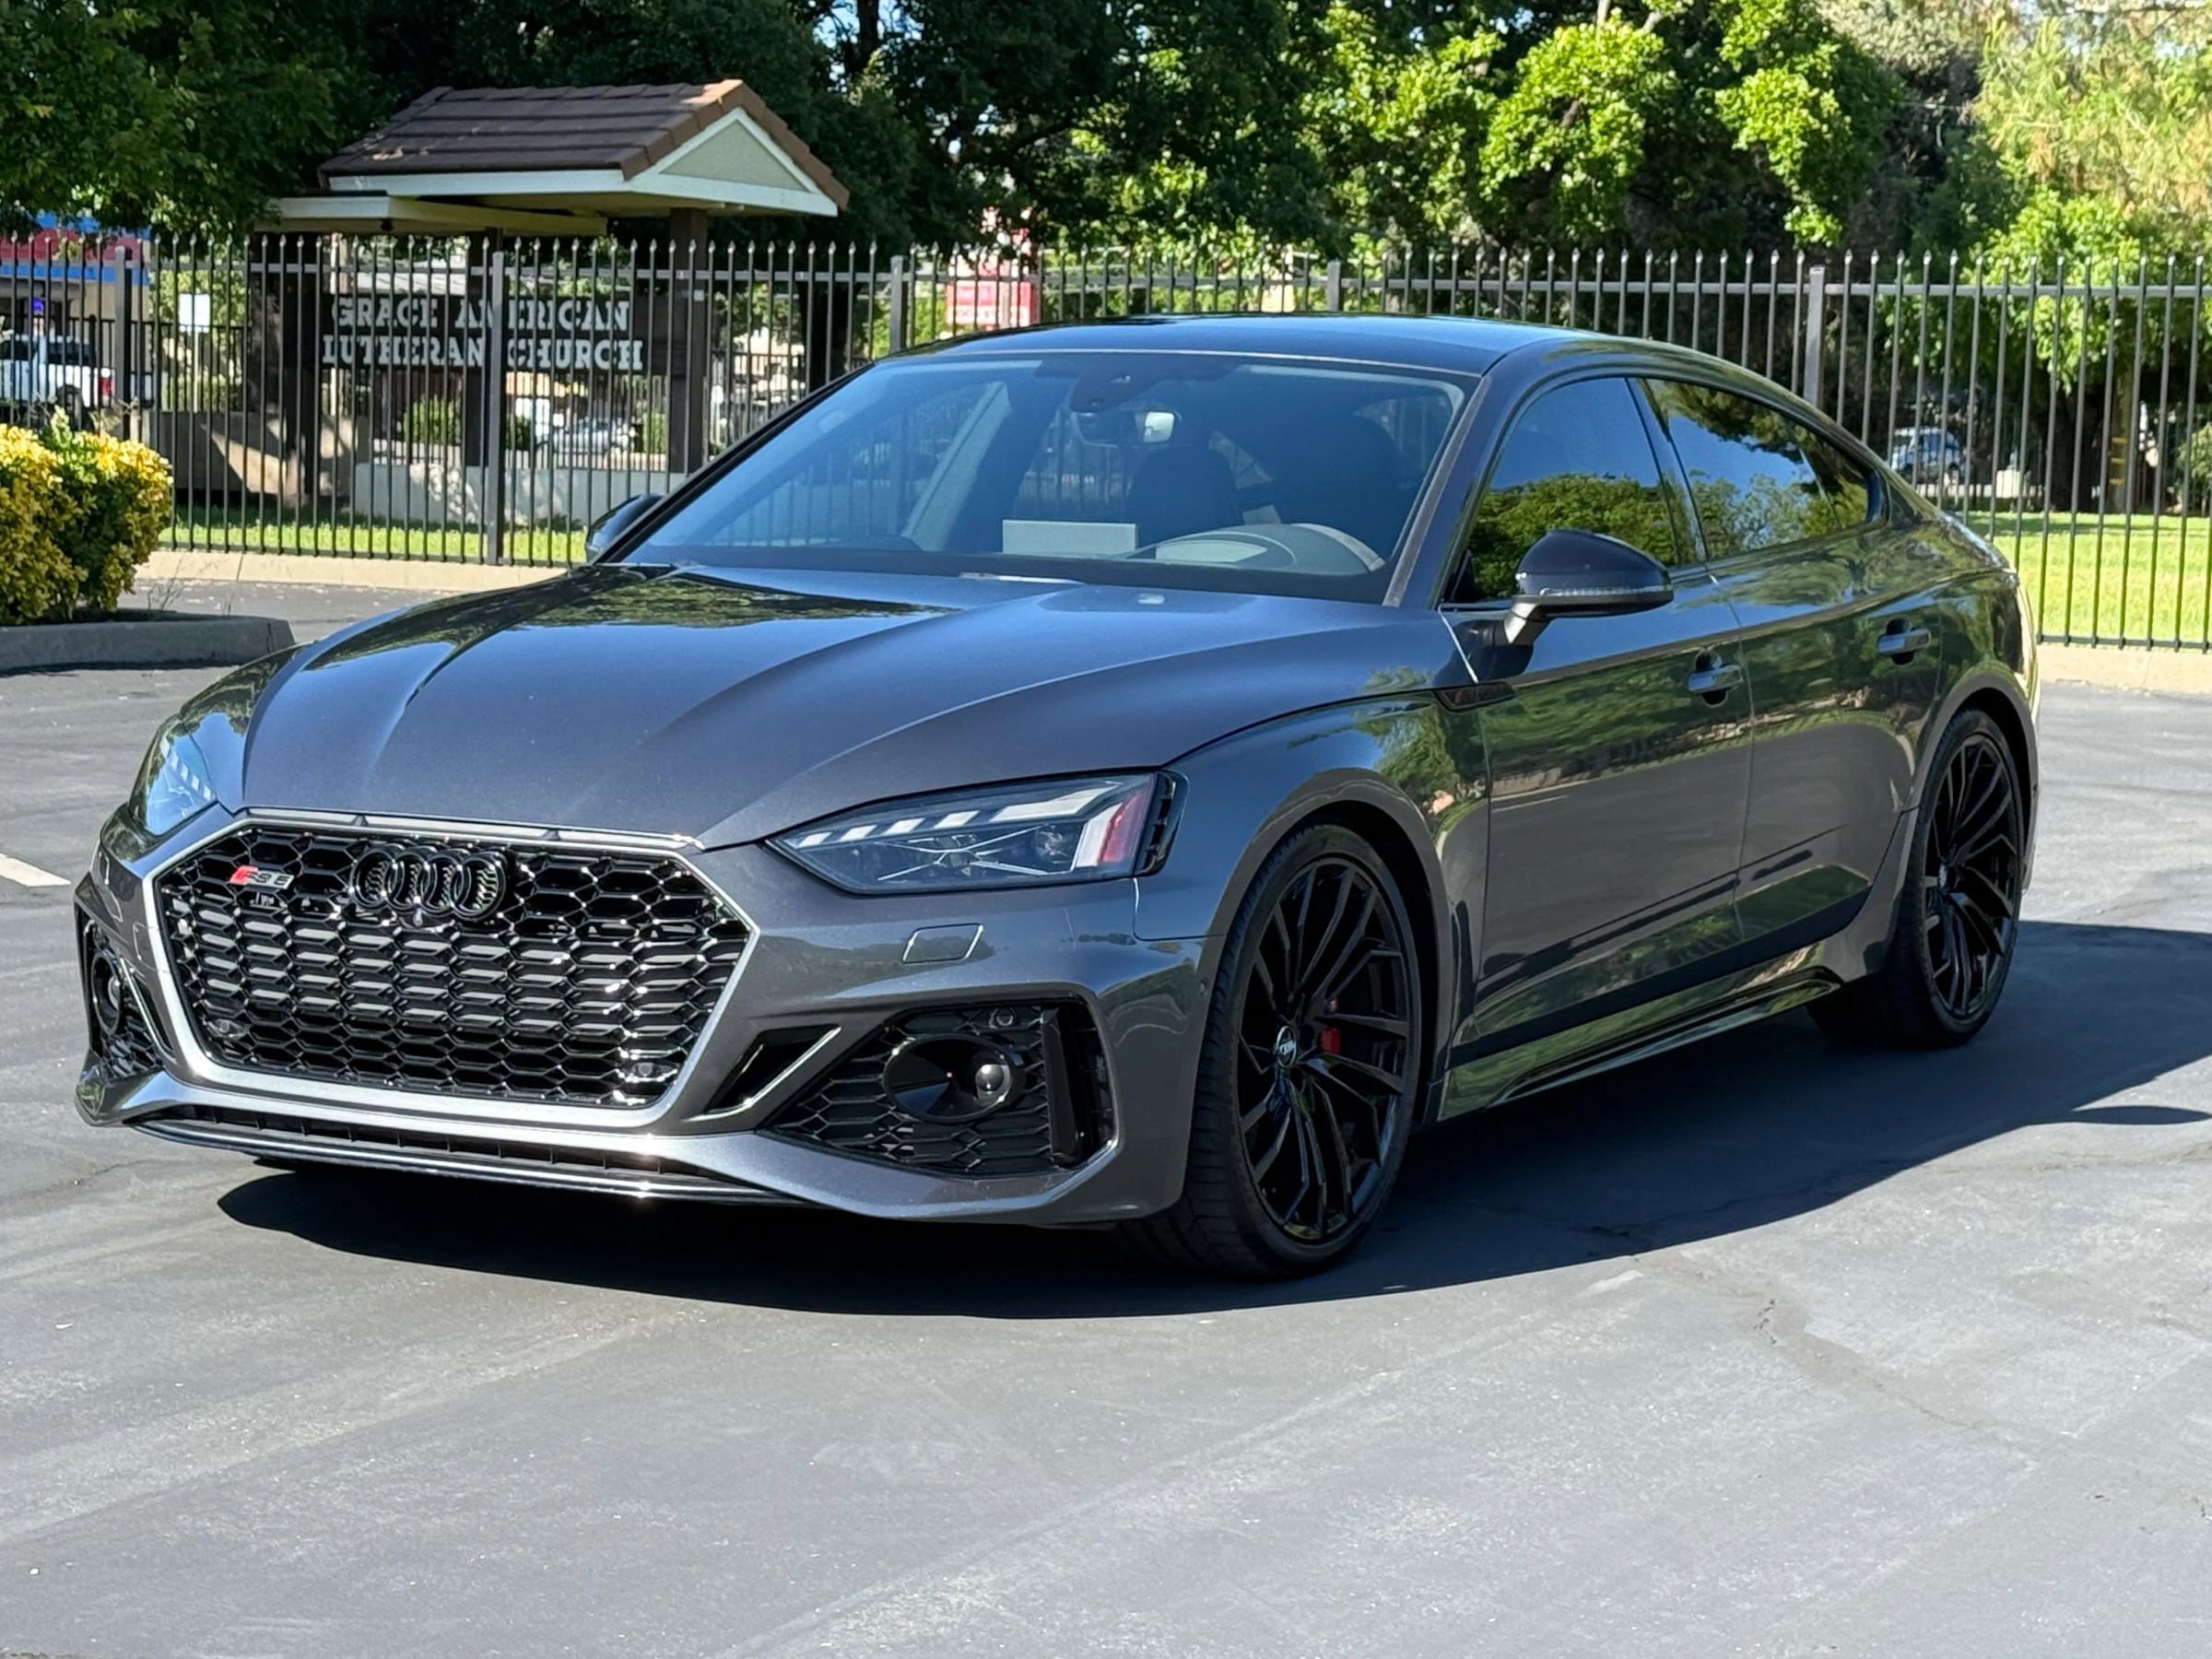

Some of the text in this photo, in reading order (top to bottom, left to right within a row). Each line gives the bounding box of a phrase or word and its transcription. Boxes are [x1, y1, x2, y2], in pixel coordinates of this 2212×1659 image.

[332, 297, 438, 328] GRACE
[324, 335, 643, 370] LUTHERAN CHURCH
